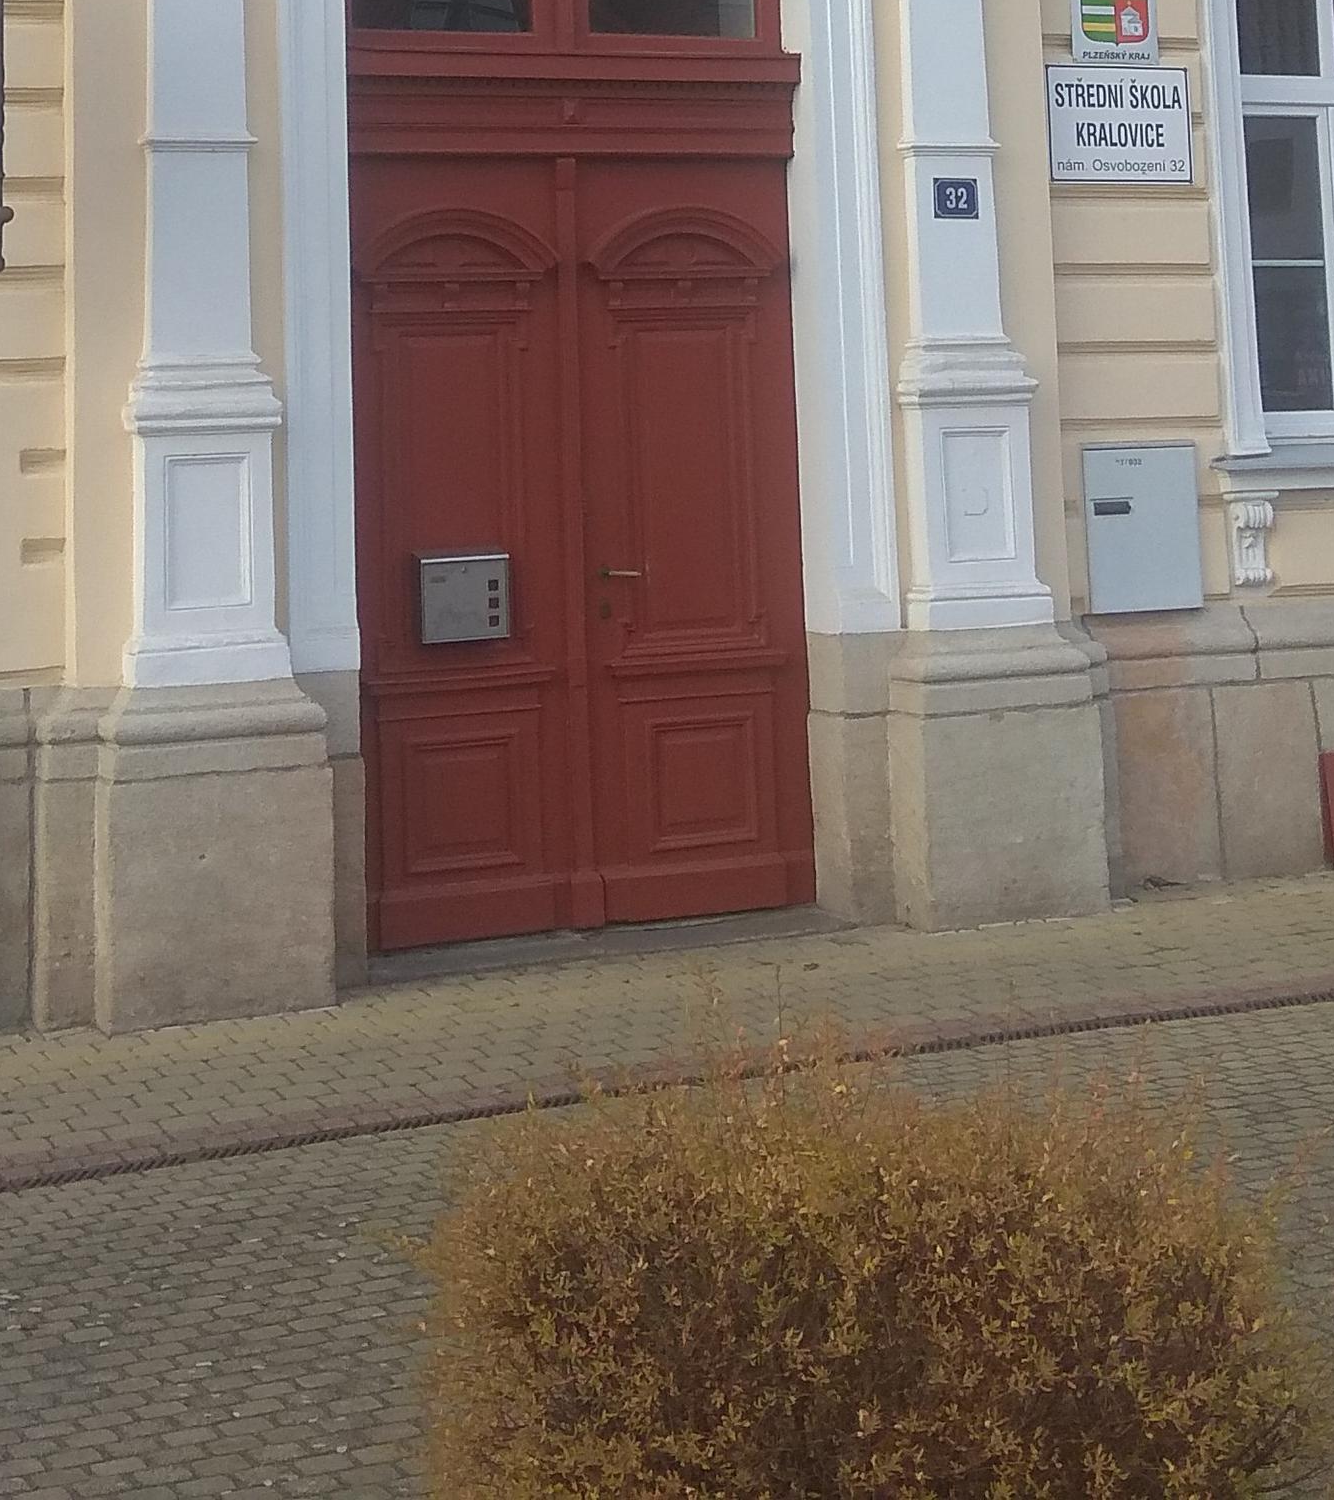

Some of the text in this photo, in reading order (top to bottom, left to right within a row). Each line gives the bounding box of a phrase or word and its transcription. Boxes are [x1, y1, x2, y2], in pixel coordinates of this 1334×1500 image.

[1082, 49, 1151, 61] PLZEŇSKÝ KRAJ
[1054, 76, 1183, 110] STŘEDNÍ ŠKOLA
[1075, 122, 1166, 148] KRALOVICE
[1092, 158, 1166, 172] Osvobození
[1170, 159, 1185, 172] 32
[945, 187, 968, 209] 32
